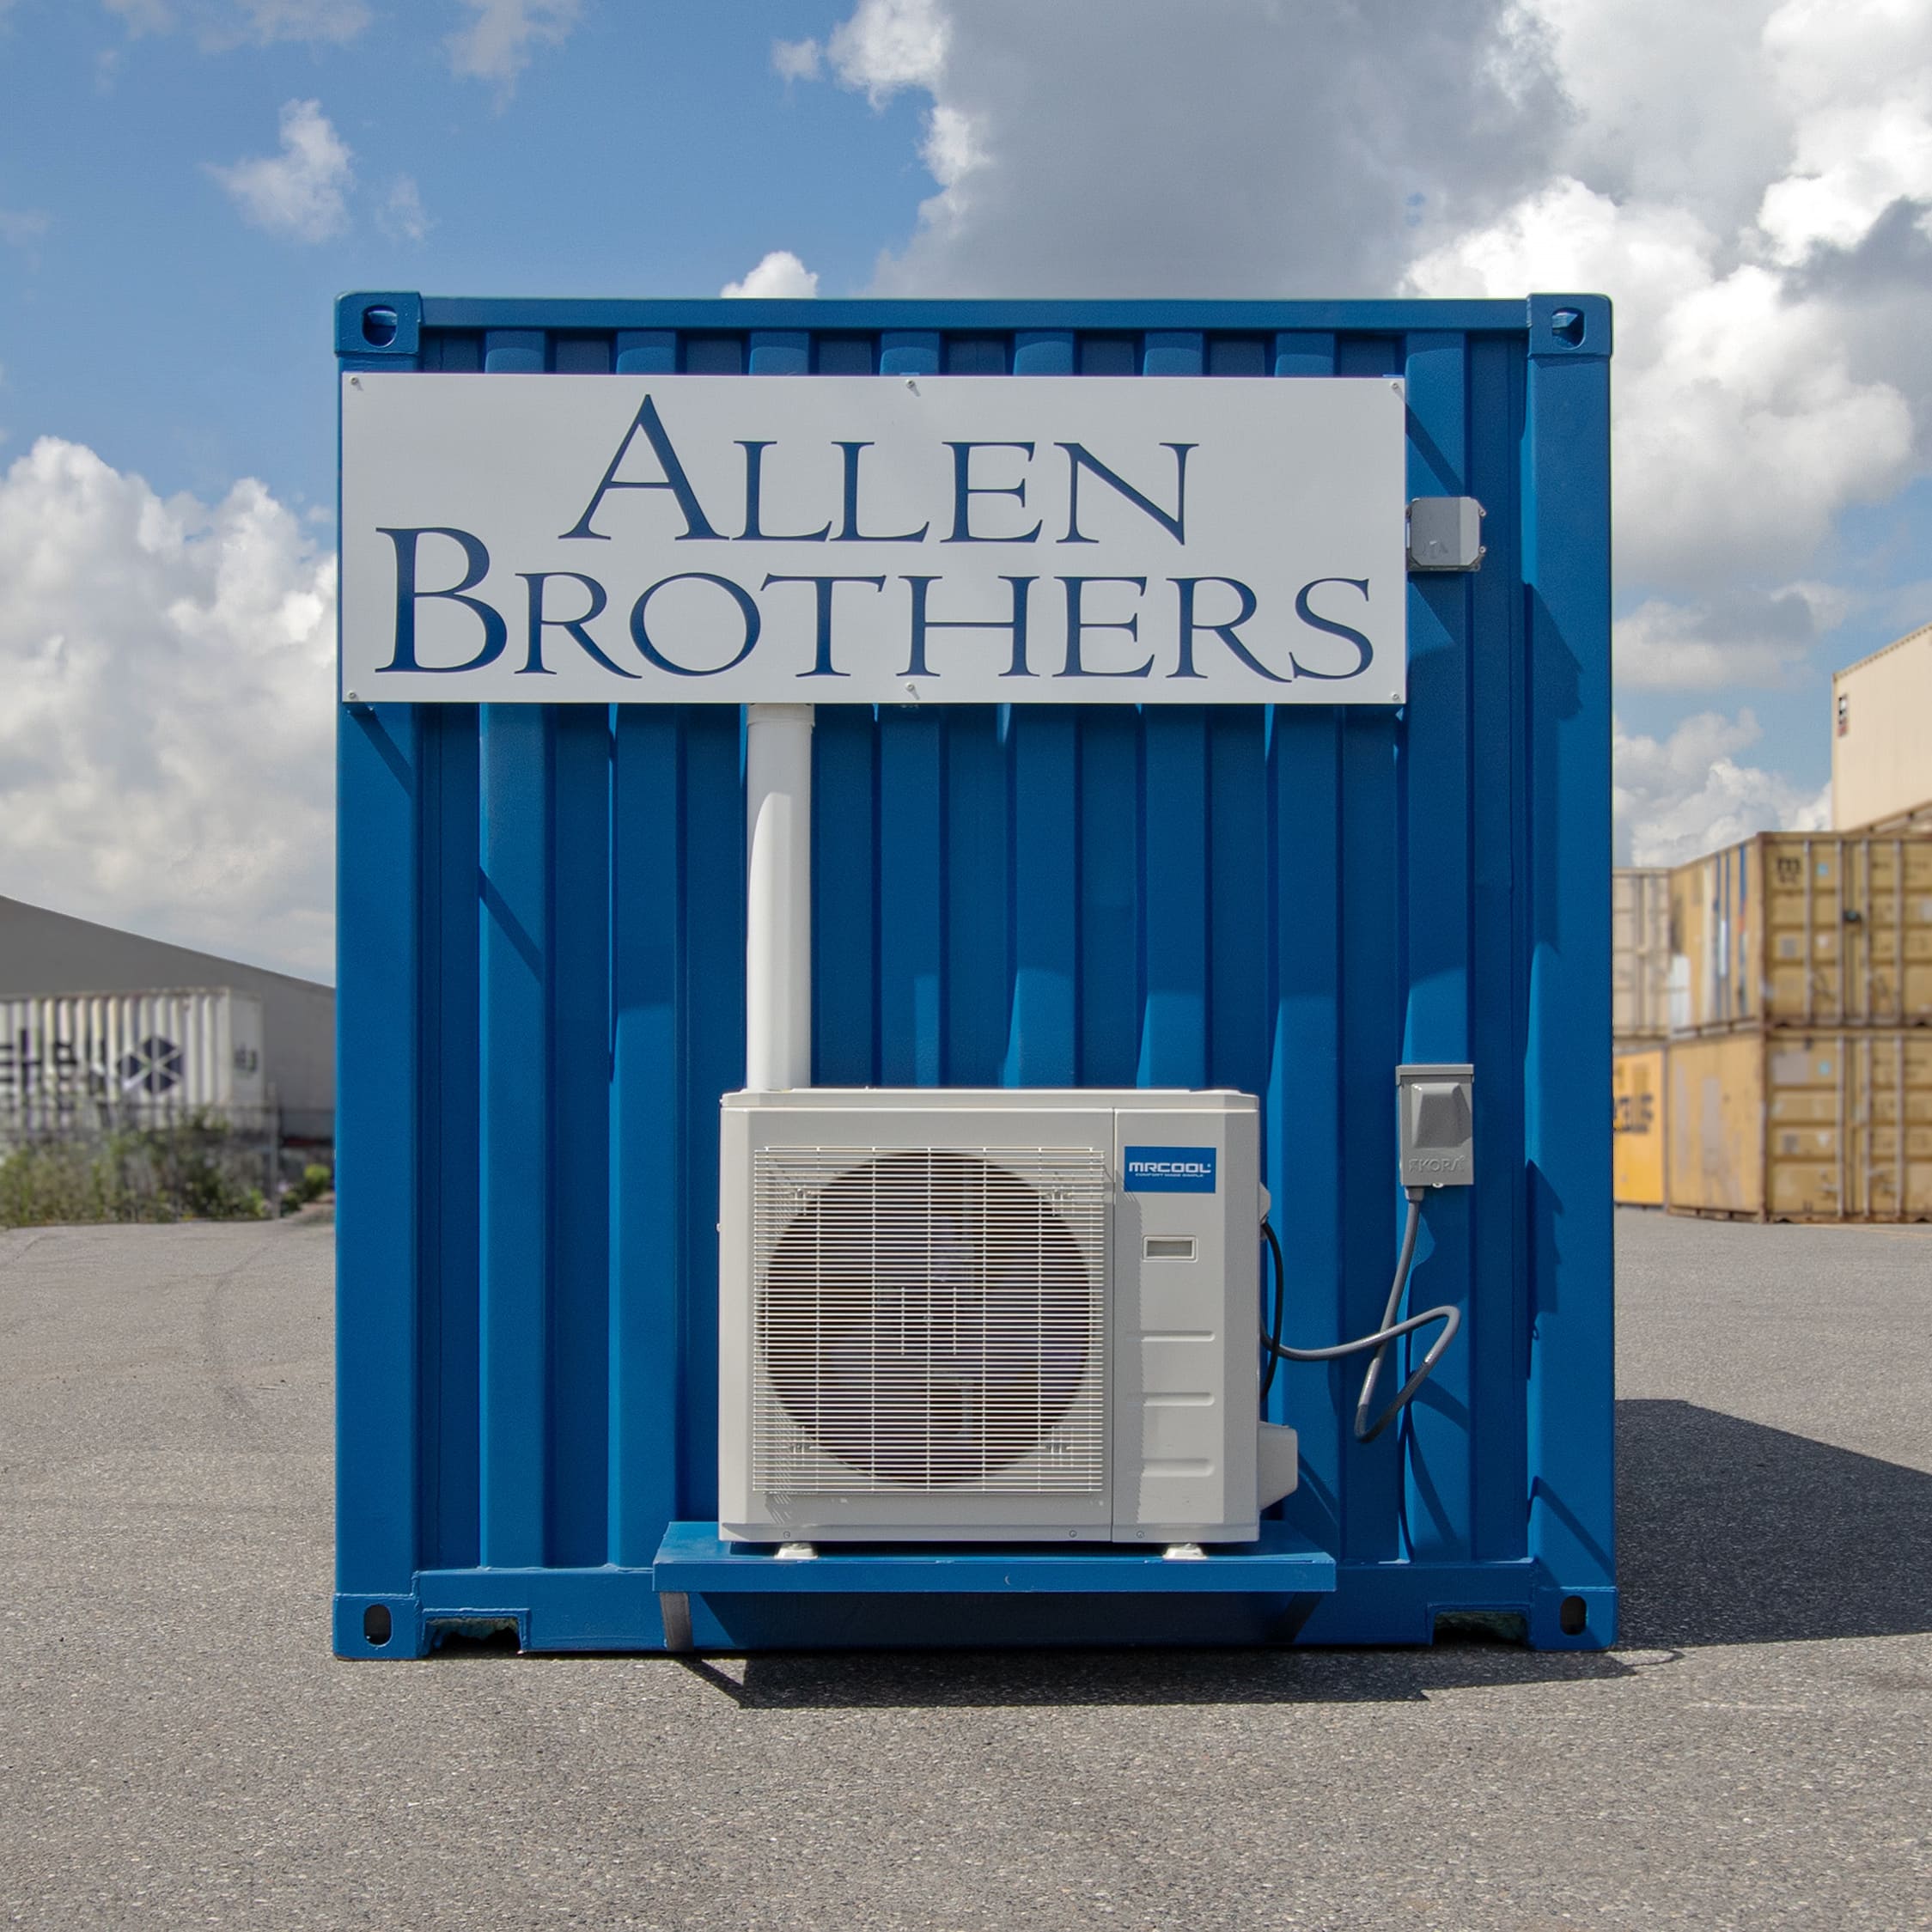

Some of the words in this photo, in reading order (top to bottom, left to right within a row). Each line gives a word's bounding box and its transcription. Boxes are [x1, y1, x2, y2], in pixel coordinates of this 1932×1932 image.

[558, 394, 1199, 545] ALLEN
[375, 527, 1374, 682] BROTHERS
[1129, 1161, 1211, 1173] MRCOOL
